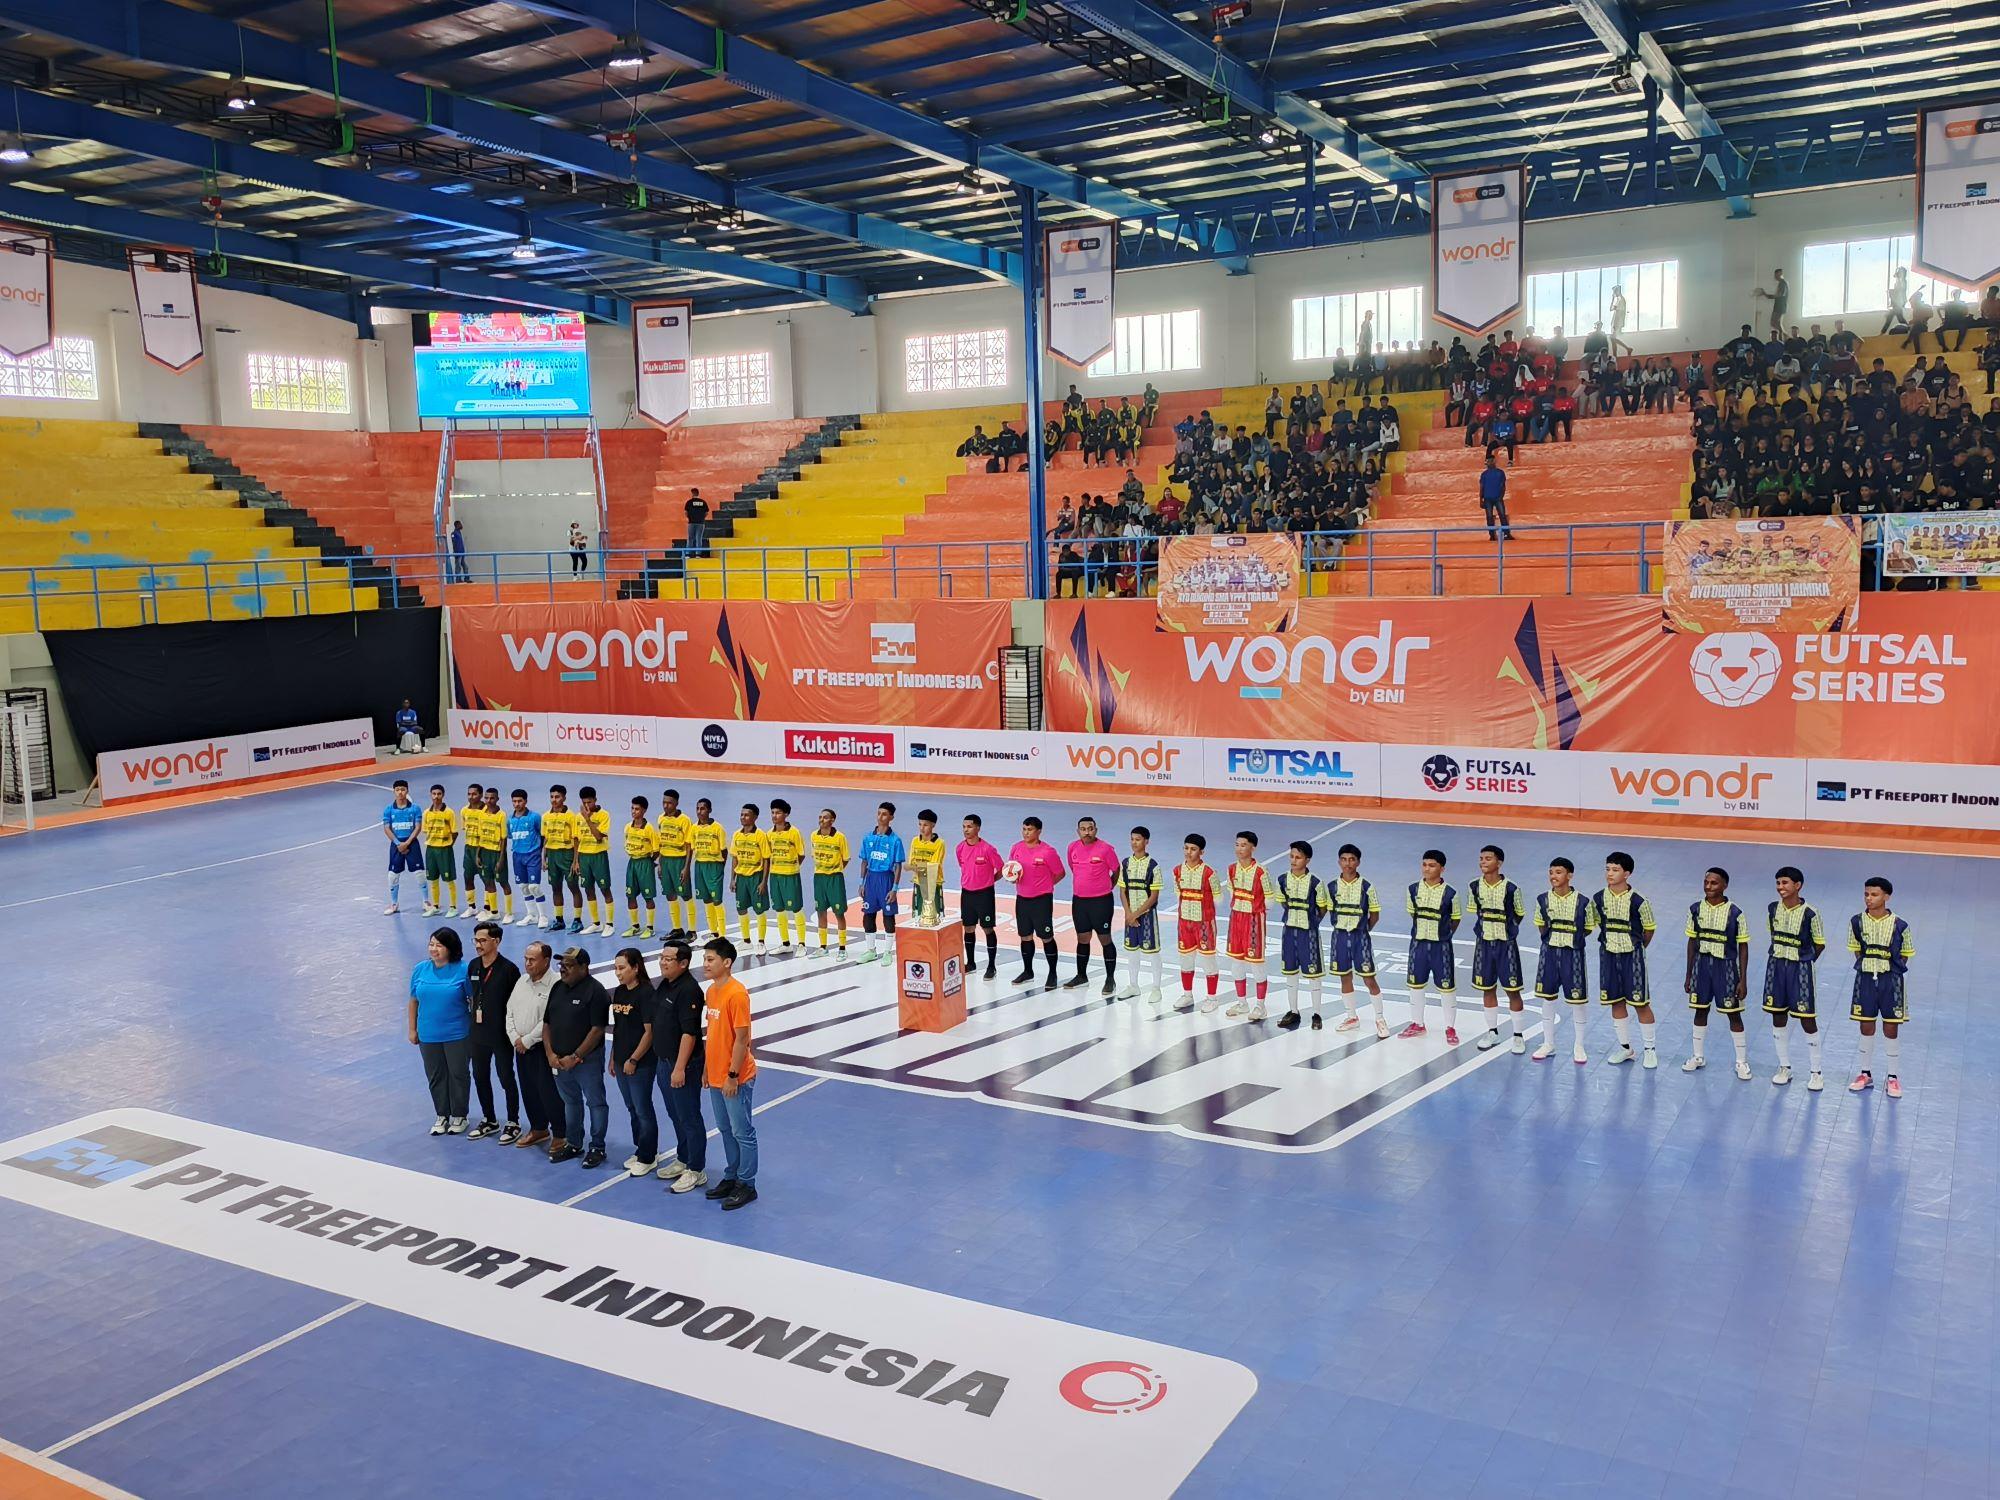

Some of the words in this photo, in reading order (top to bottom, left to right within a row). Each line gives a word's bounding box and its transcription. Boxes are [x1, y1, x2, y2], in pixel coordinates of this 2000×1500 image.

[1442, 237, 1516, 262] wondr
[644, 362, 684, 372] KukuBima
[501, 617, 688, 672] wondr
[1183, 620, 1430, 685] wondr
[1795, 634, 1967, 666] FUTSAL
[643, 670, 657, 683] by
[657, 670, 678, 683] BNI
[792, 668, 816, 686] PT
[817, 668, 894, 687] FREEPORT
[896, 671, 983, 690] INDONESIA
[1349, 689, 1369, 705] by
[1373, 689, 1405, 703] BNI
[1791, 672, 1946, 704] SERIES
[461, 716, 533, 740] wondr
[272, 748, 283, 757] PT
[285, 744, 322, 755] FREEPORT
[323, 738, 361, 750] INDONESIA
[703, 734, 726, 743] NIVEA
[793, 735, 885, 757] KukuBima
[122, 743, 228, 782] wondr
[929, 747, 941, 756] PT
[942, 748, 982, 759] FREEPORT
[984, 750, 1029, 760] INDONESIA
[1066, 740, 1181, 772] wondr
[1228, 748, 1353, 778] FUTSAL
[200, 772, 209, 780] by
[210, 770, 223, 778] BNI
[1146, 772, 1157, 781] by
[1158, 772, 1172, 780] BNI
[1466, 759, 1536, 776] FUTSAL
[1466, 777, 1528, 793] SERIES
[1610, 762, 1773, 800] wondr
[1851, 788, 1872, 799] PT
[1875, 789, 1948, 803] FREEPORT
[1723, 801, 1737, 812] by
[1739, 801, 1759, 810] BNI
[1766, 996, 1773, 1006] 3
[131, 1163, 269, 1204] PT
[220, 1185, 569, 1289] FREEPORT
[541, 1265, 1010, 1418] INDONESIA
